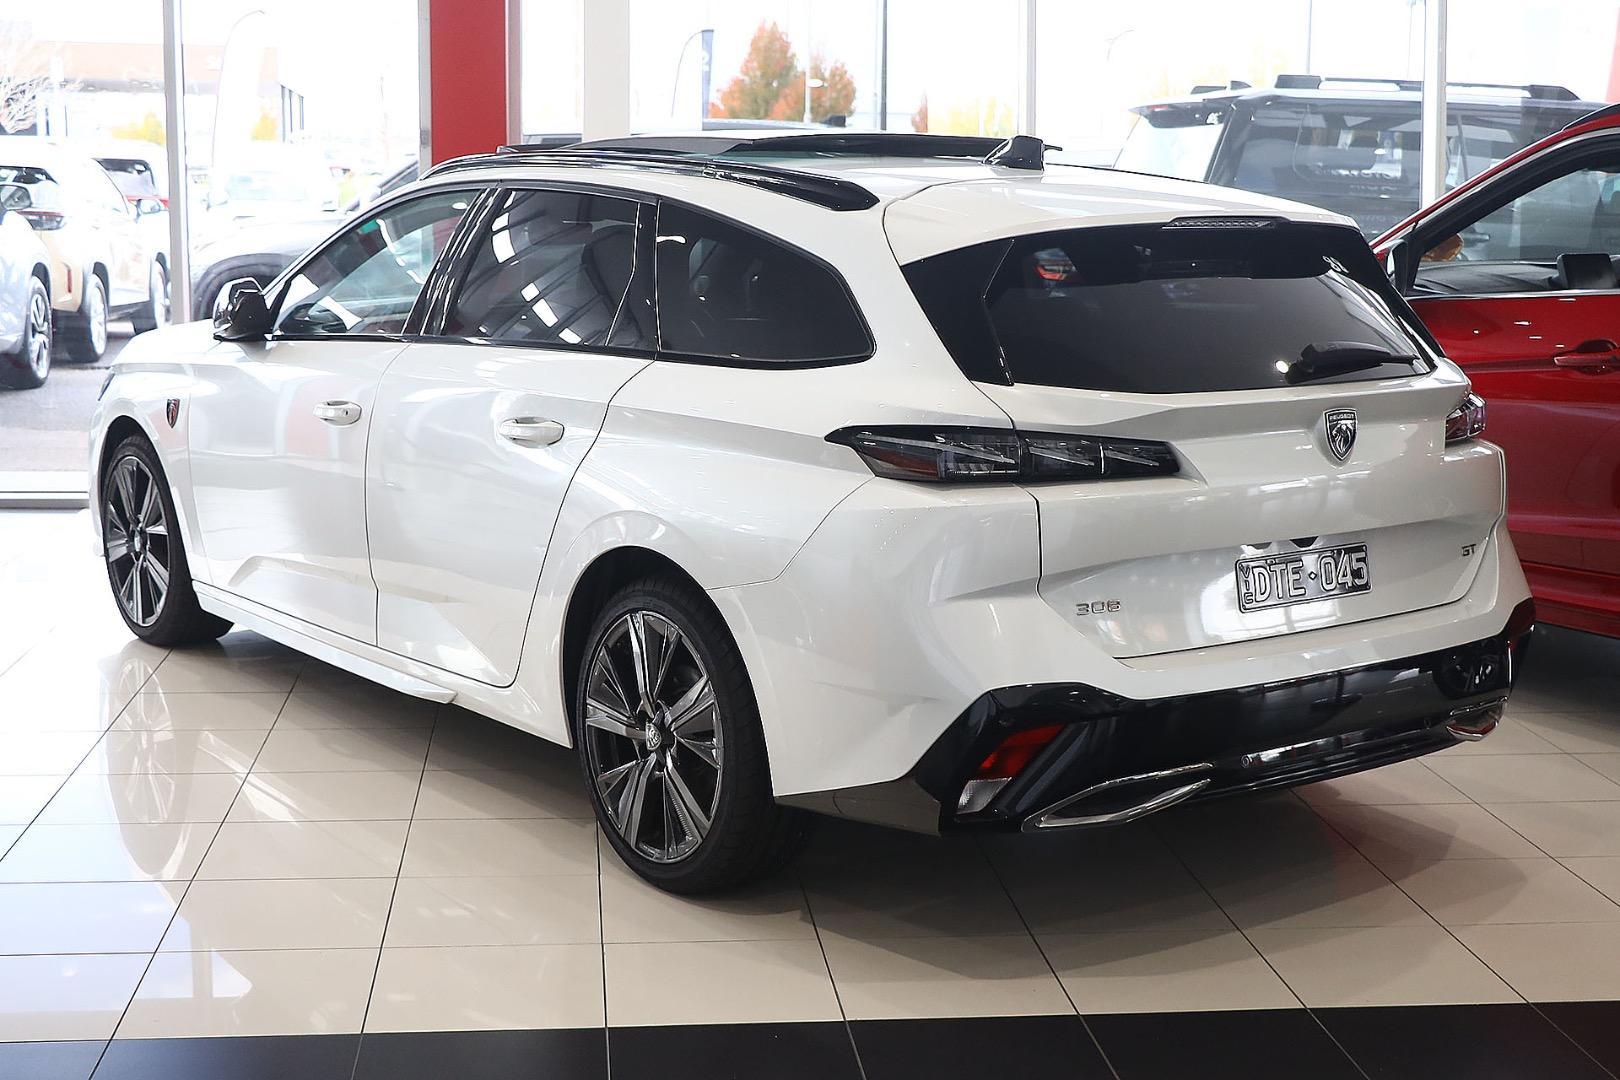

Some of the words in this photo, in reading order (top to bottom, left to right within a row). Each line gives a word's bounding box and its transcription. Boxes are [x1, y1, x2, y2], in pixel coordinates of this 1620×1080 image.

[1461, 543, 1477, 557] GT
[1239, 563, 1254, 604] VIC
[1075, 599, 1122, 616] 308
